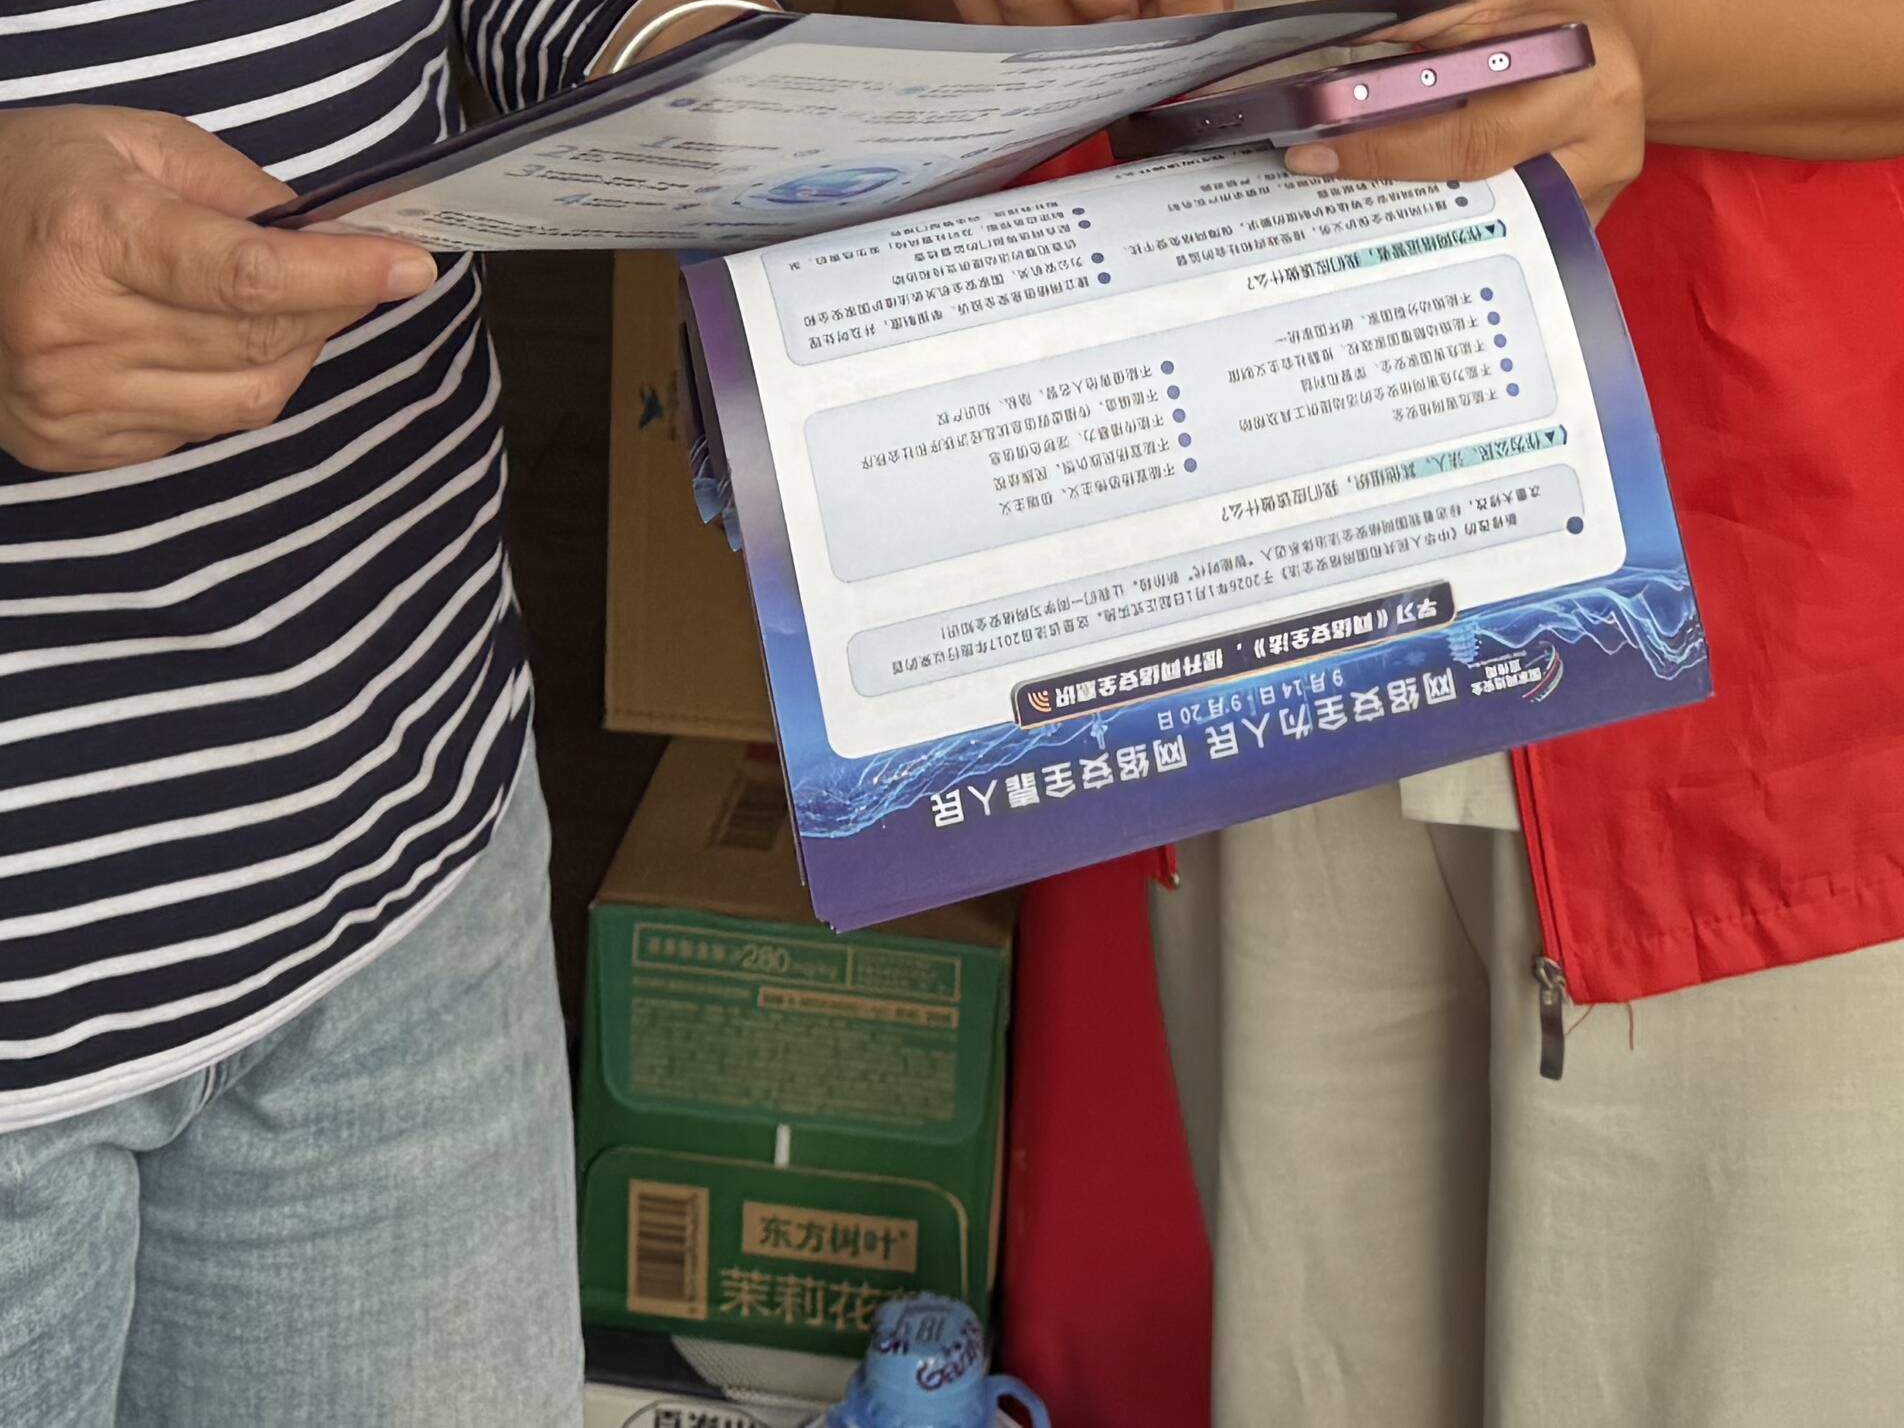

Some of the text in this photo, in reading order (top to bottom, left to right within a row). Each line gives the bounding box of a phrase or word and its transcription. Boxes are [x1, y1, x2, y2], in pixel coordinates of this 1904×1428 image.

[927, 666, 1458, 828] 网络安全为人民 网络安全靠人民
[759, 1214, 896, 1260] 东方树叶
